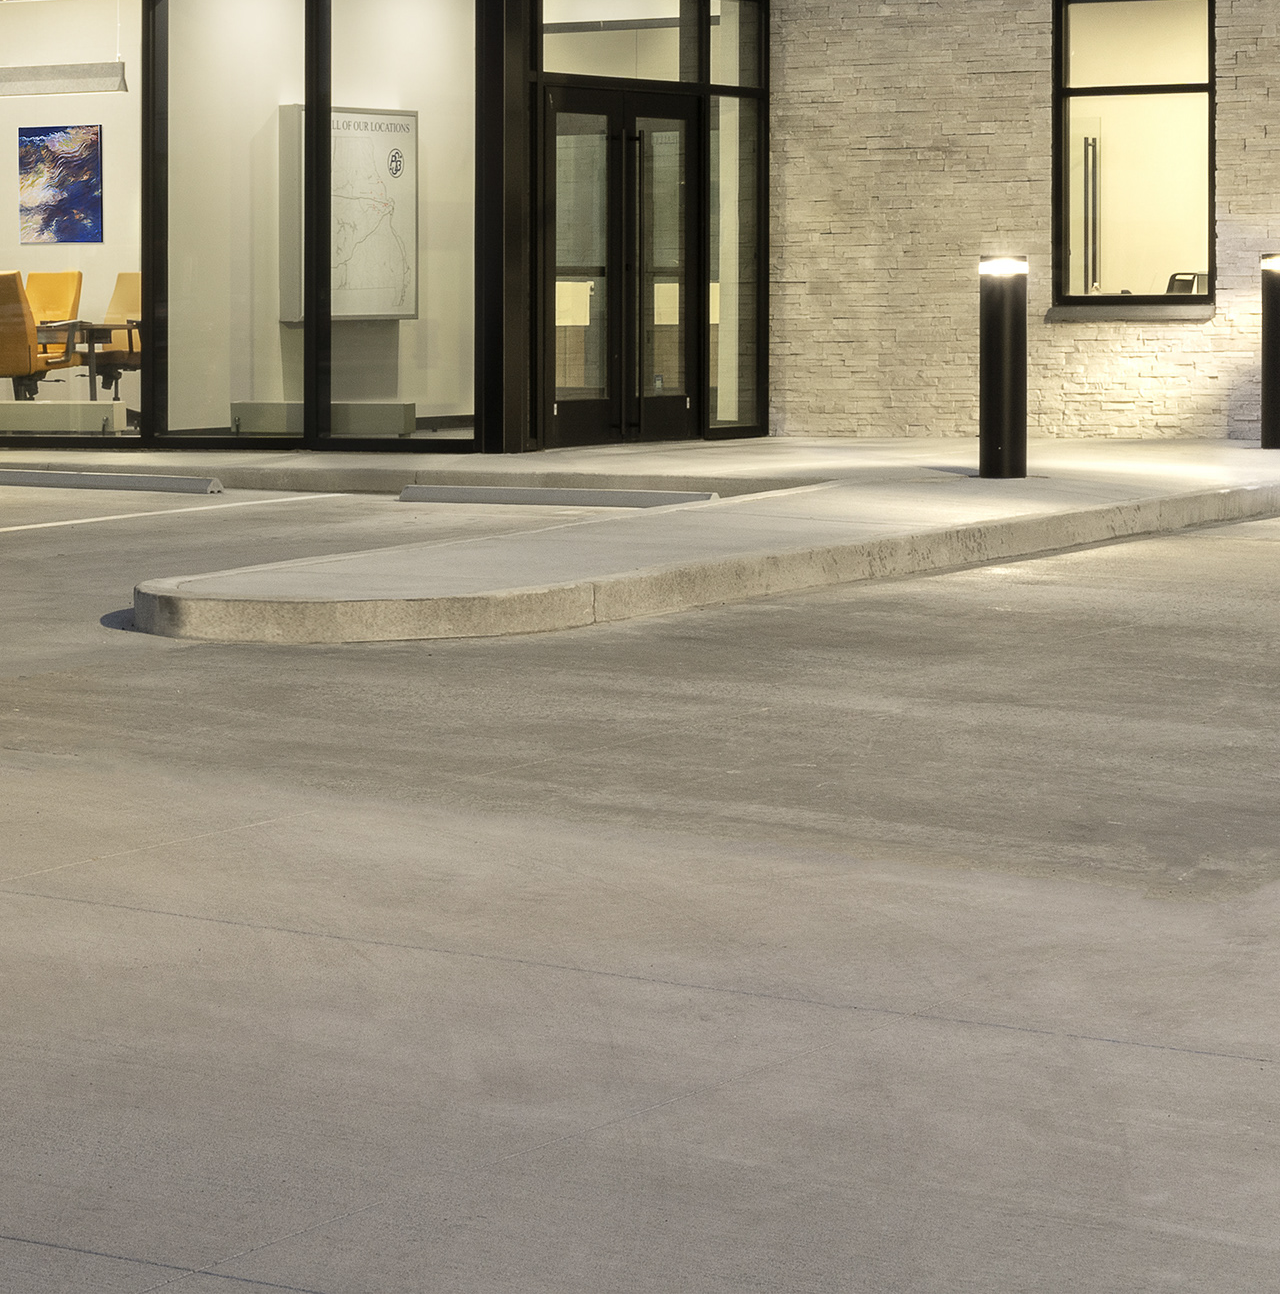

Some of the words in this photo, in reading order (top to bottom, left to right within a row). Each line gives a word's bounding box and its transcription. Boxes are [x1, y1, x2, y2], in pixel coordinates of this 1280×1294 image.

[342, 120, 352, 131] OF
[353, 121, 369, 132] OUR
[370, 122, 411, 133] LOCATIONS
